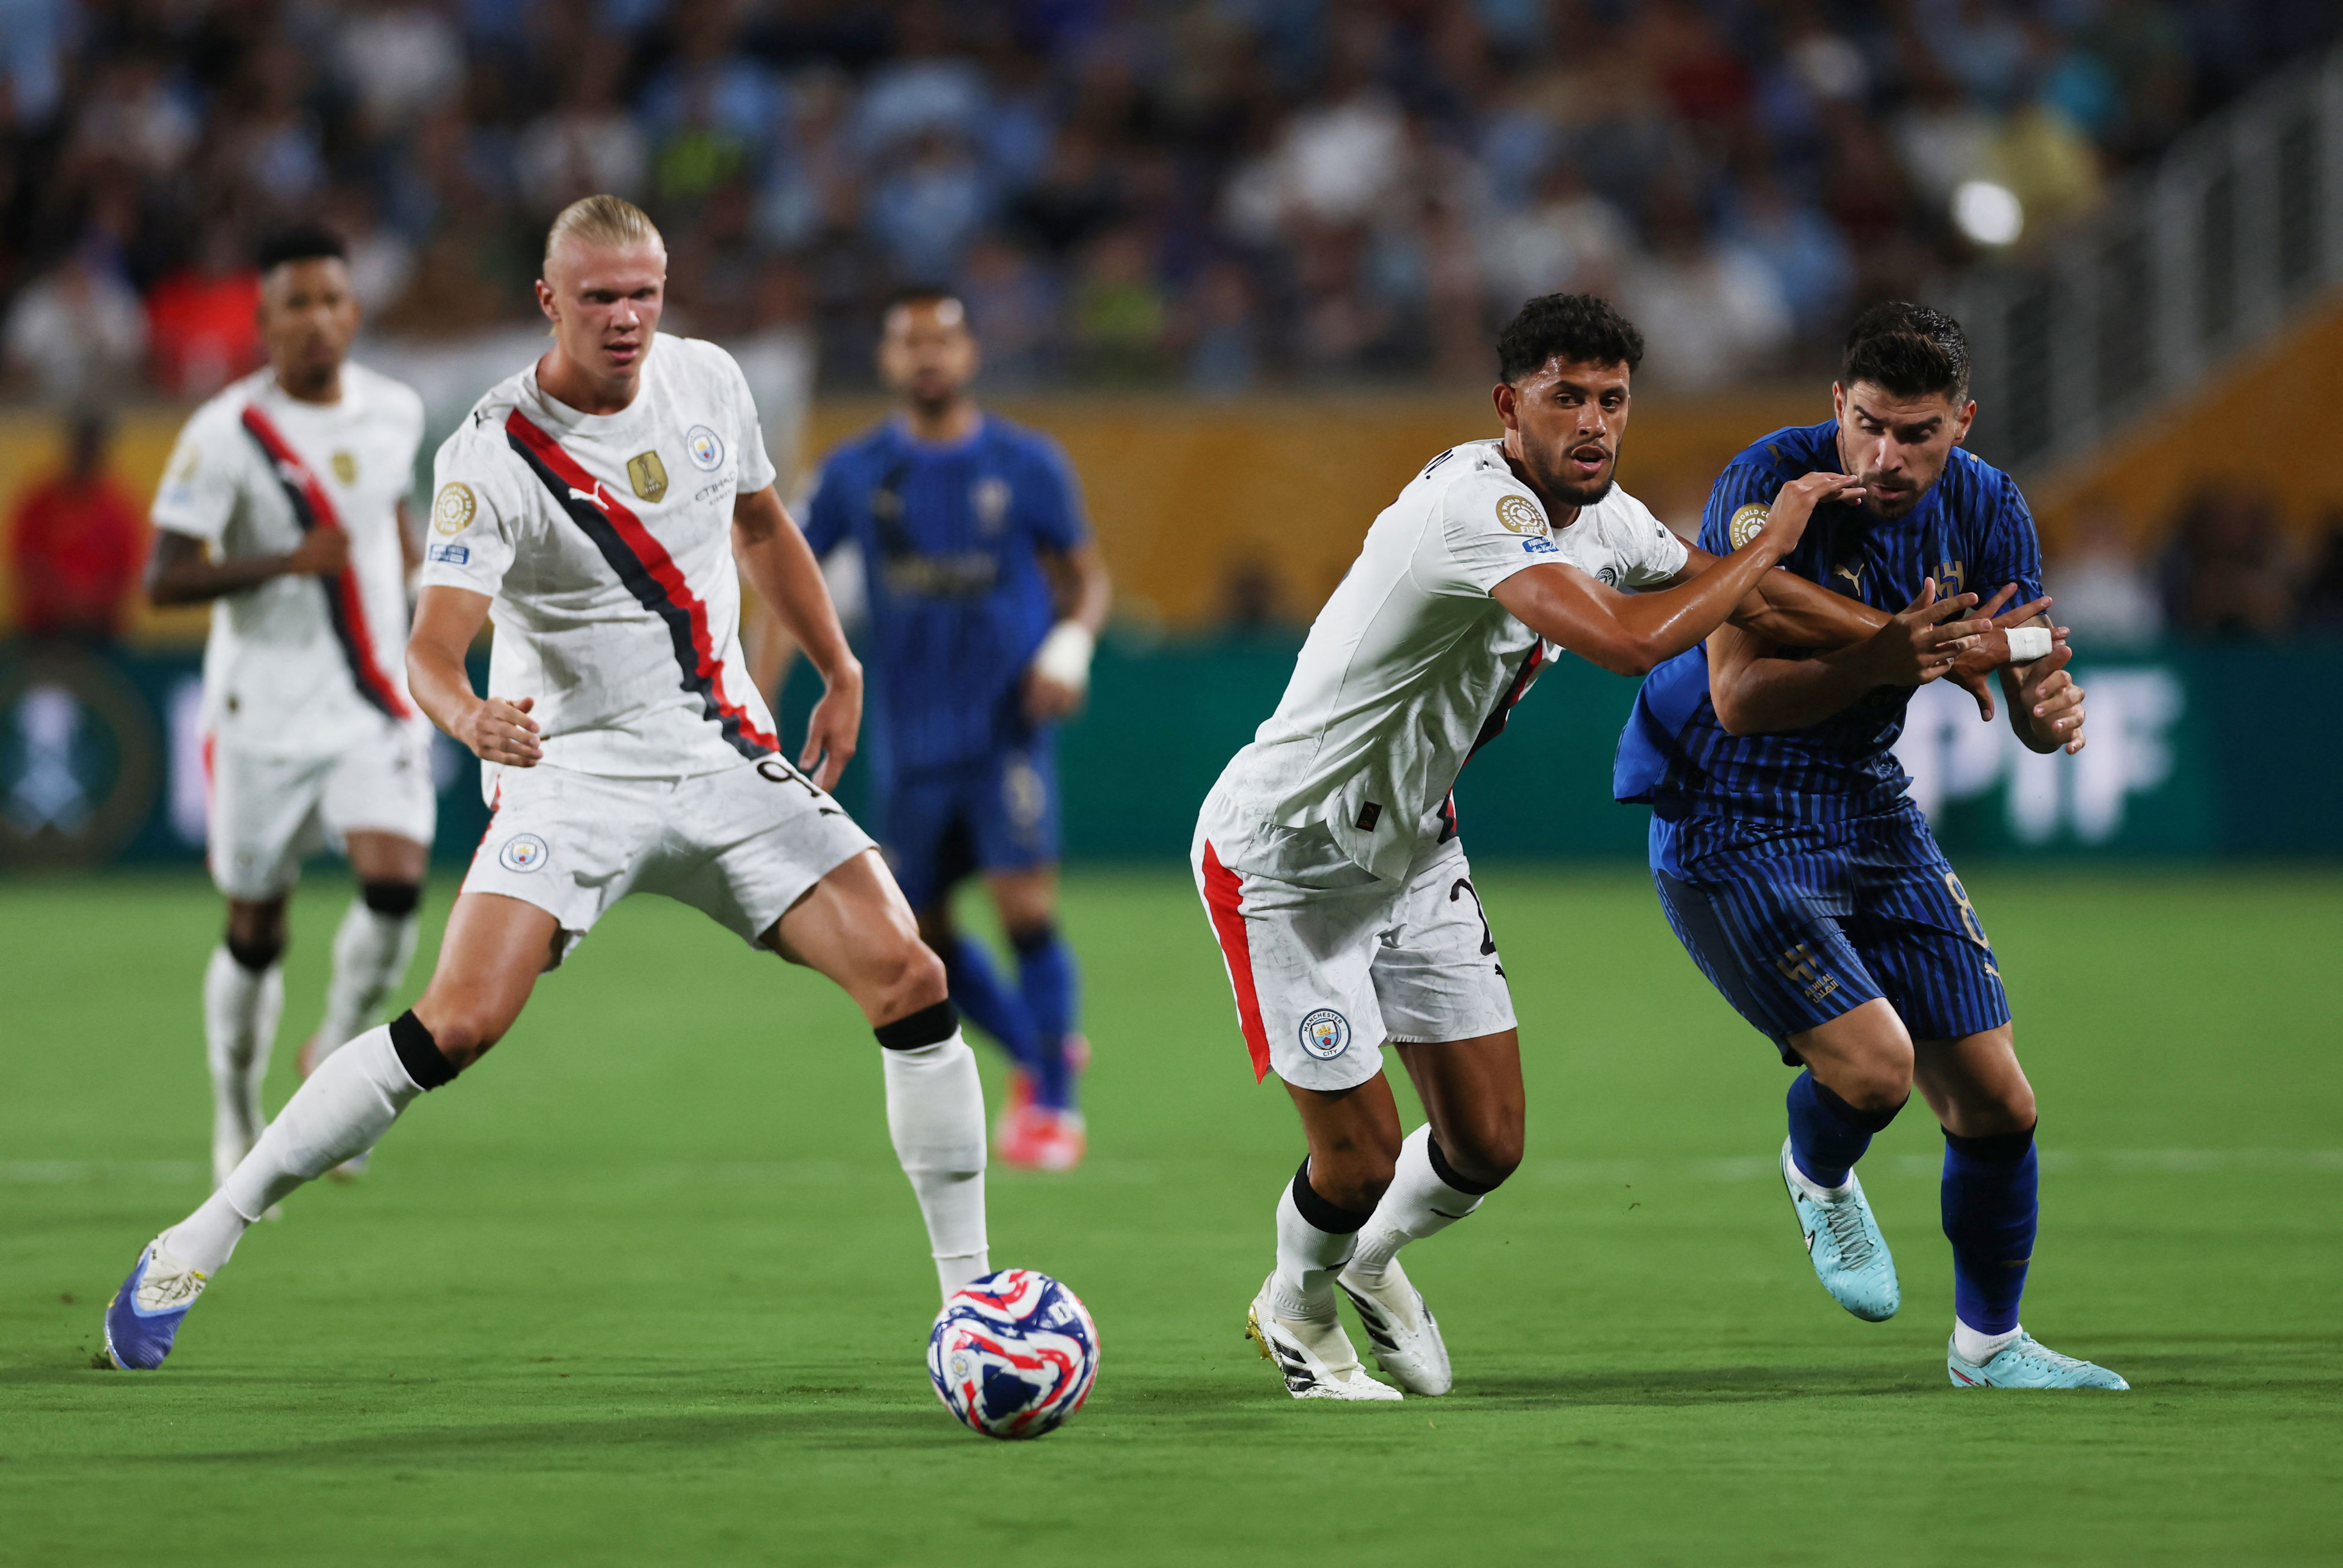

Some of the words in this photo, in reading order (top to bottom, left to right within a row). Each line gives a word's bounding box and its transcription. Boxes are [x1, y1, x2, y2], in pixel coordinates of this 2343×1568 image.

[1502, 499, 1520, 510] WORLD
[1502, 512, 1516, 526] CLUB
[1736, 509, 1759, 525] WORLD
[1734, 527, 1743, 546] CLUB
[757, 761, 822, 798] 9
[1945, 872, 1989, 949] 8
[1304, 1012, 1343, 1032] MANCHESTER
